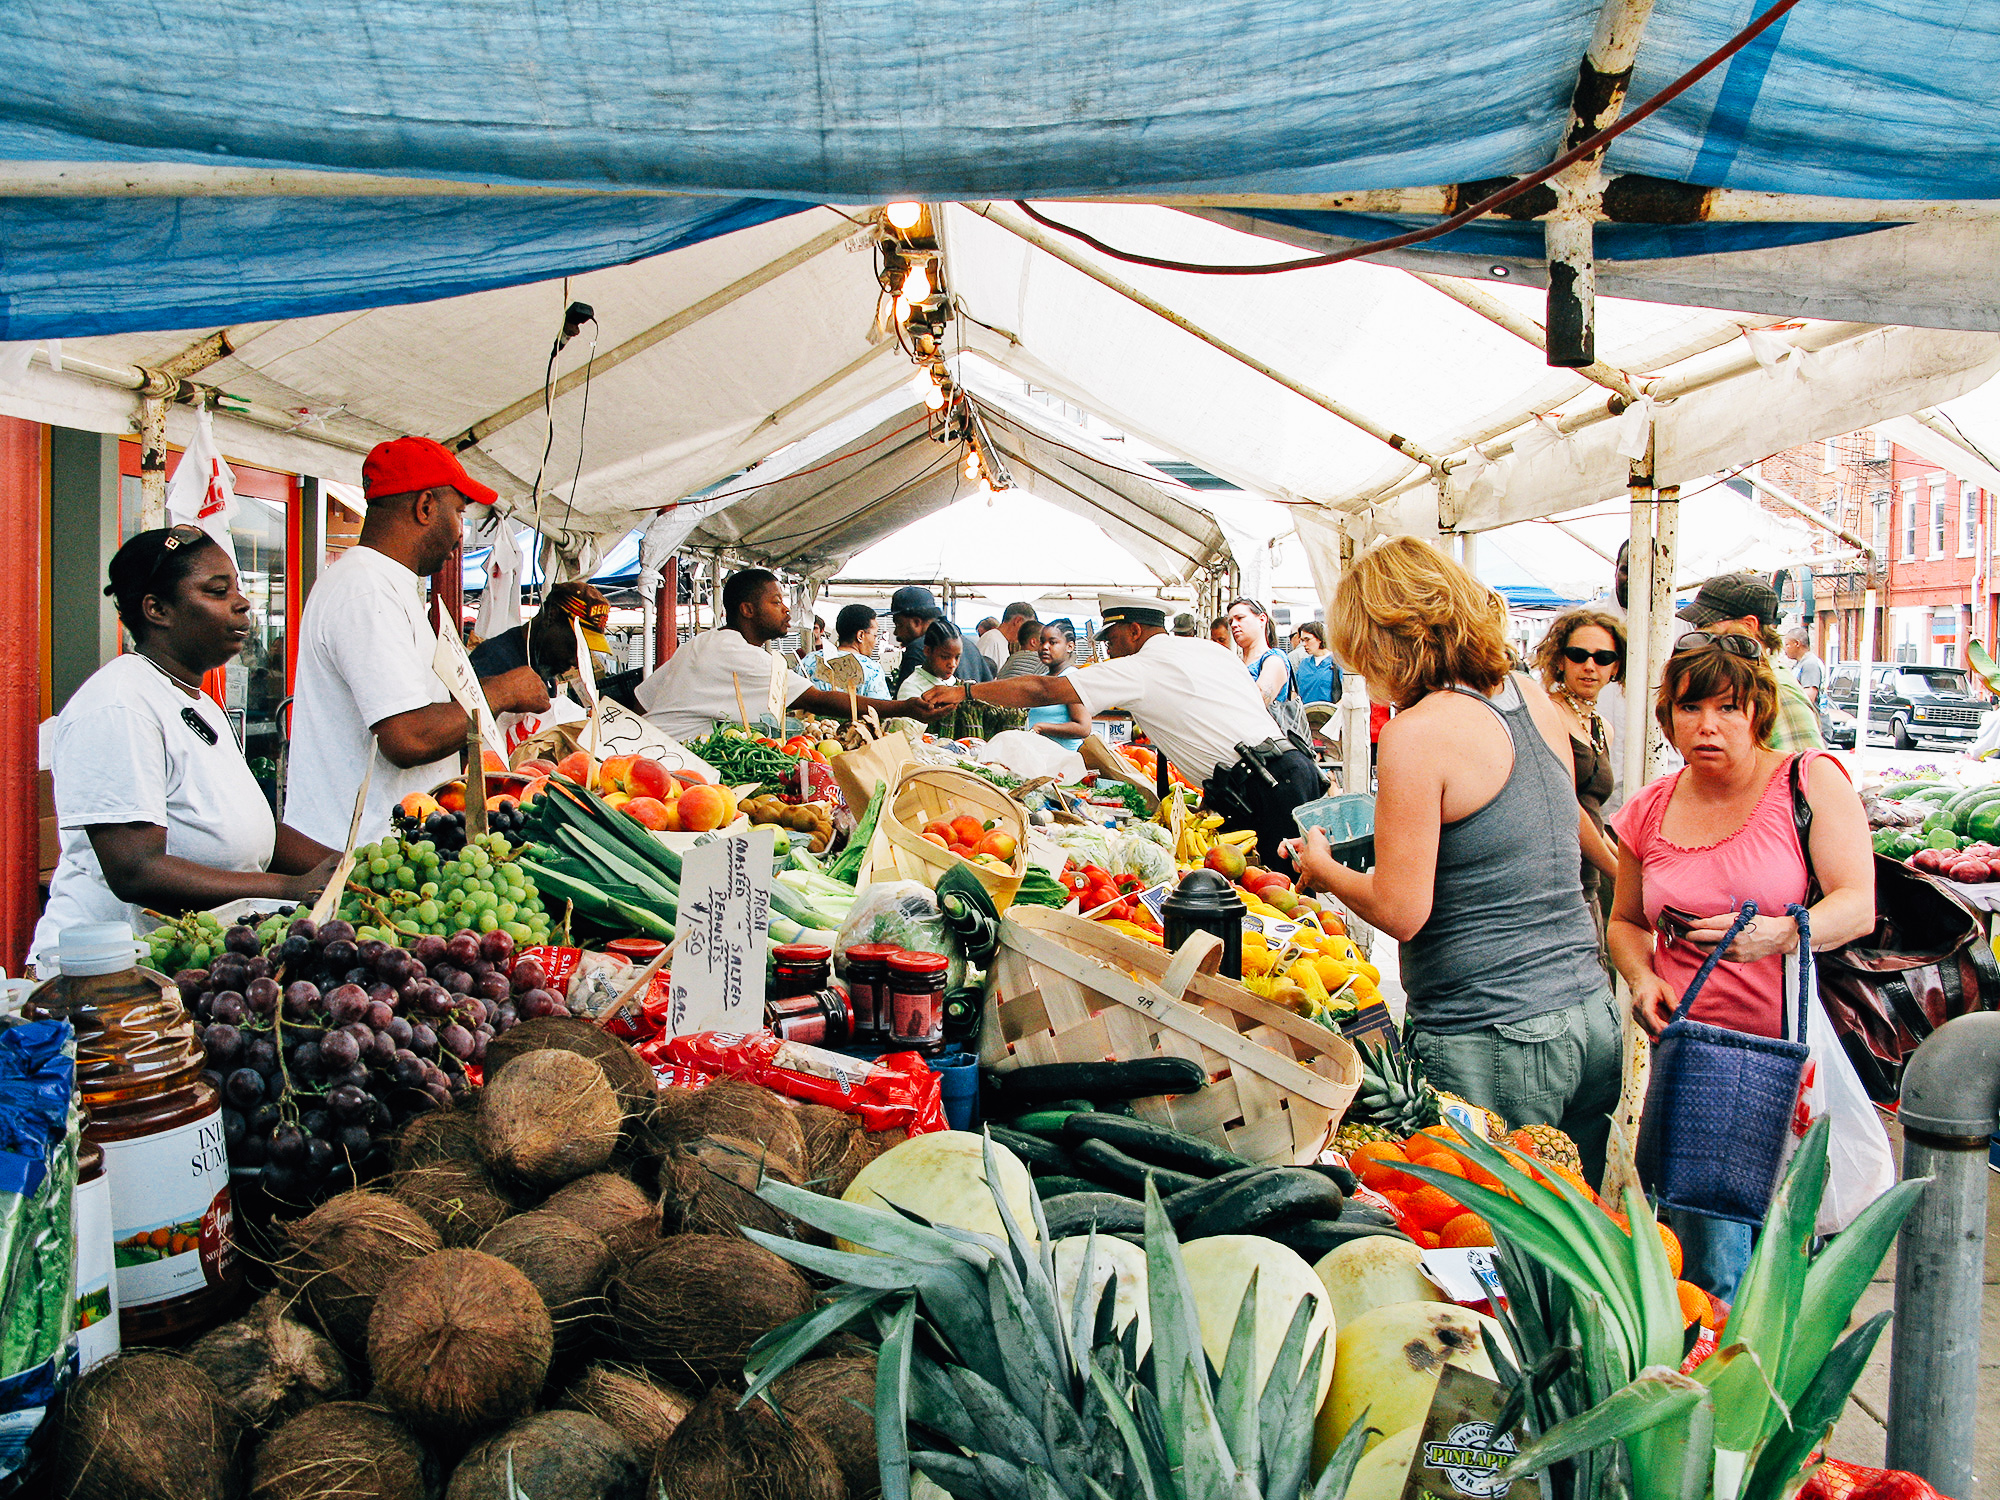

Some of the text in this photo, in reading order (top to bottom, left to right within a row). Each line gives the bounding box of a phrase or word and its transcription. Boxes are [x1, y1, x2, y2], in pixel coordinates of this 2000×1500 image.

[735, 837, 749, 898] ROASTED
[713, 891, 728, 963] PEANUTS
[754, 888, 770, 932] FRESH
[730, 943, 743, 1008] SALTED
[1431, 1447, 1511, 1469] PINEAPP
